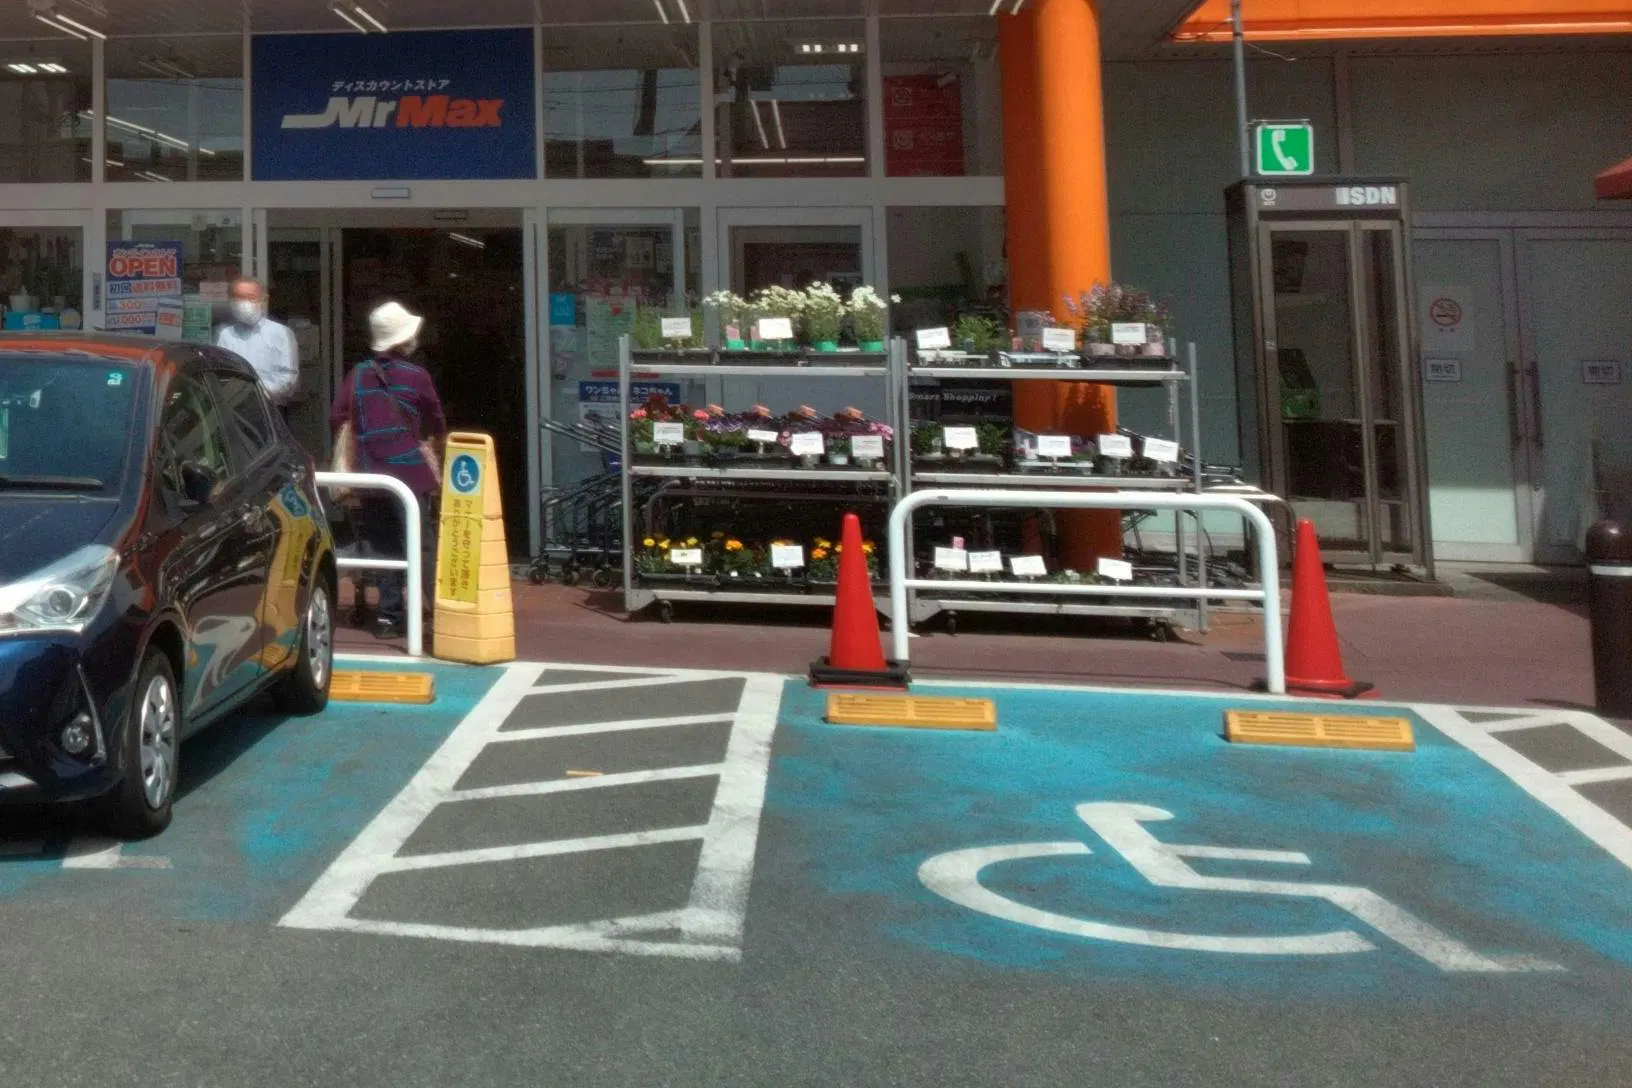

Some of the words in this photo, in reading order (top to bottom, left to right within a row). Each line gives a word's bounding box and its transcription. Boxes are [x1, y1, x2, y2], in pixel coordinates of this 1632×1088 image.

[331, 79, 451, 92] ディスカウントストア
[109, 256, 178, 278] OPEN
